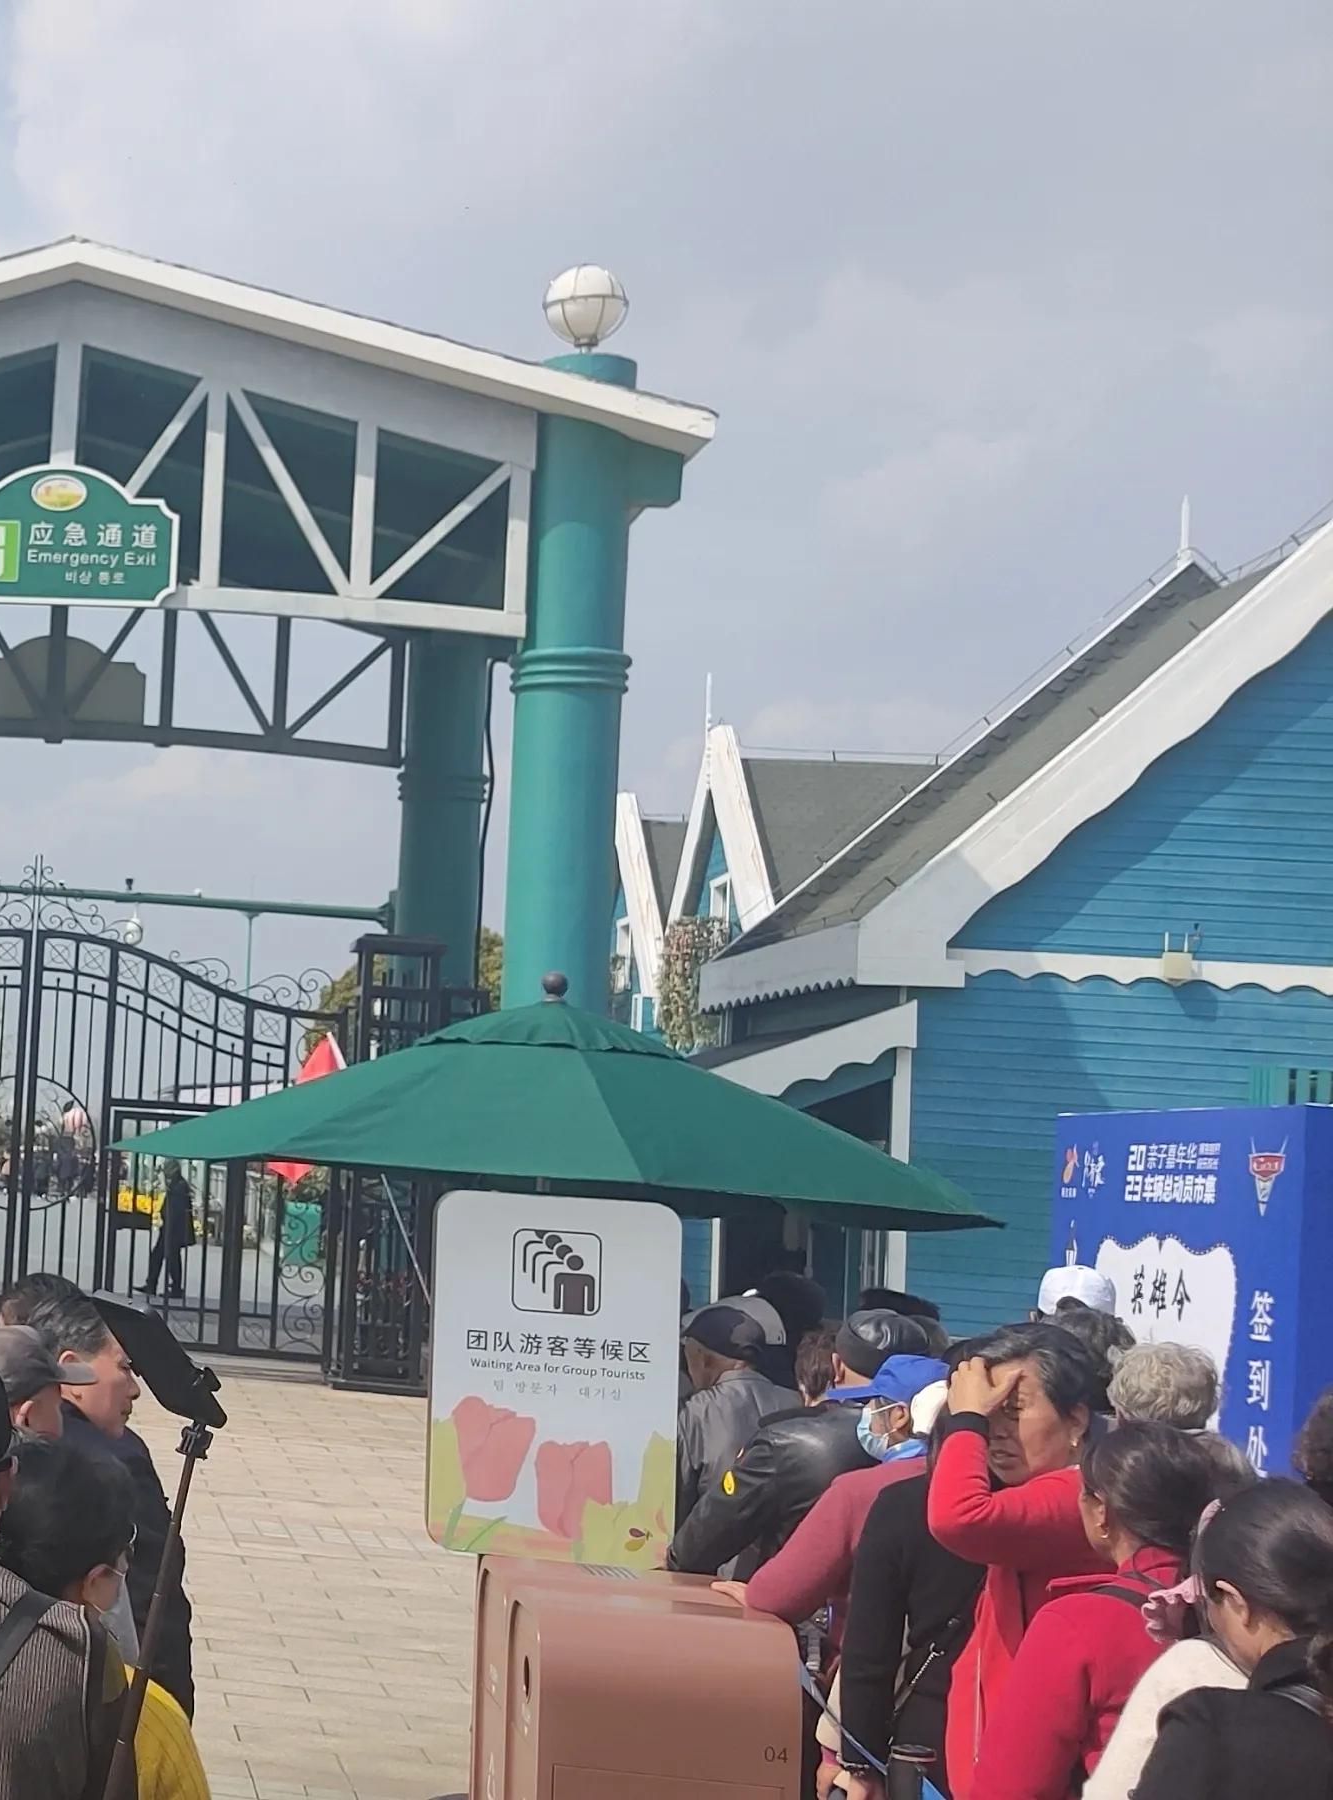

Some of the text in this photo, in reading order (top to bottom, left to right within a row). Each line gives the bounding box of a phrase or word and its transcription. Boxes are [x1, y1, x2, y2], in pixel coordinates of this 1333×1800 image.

[28, 521, 158, 549] 应急通道
[27, 549, 156, 567] Emergency Exit
[1131, 1264, 1191, 1321] 英雄令
[466, 1329, 651, 1363] 团队游客等候区
[470, 1357, 646, 1381] Waiting Area for Group Tourists
[1246, 1288, 1276, 1479] 签到处
[763, 1746, 789, 1763] 04
